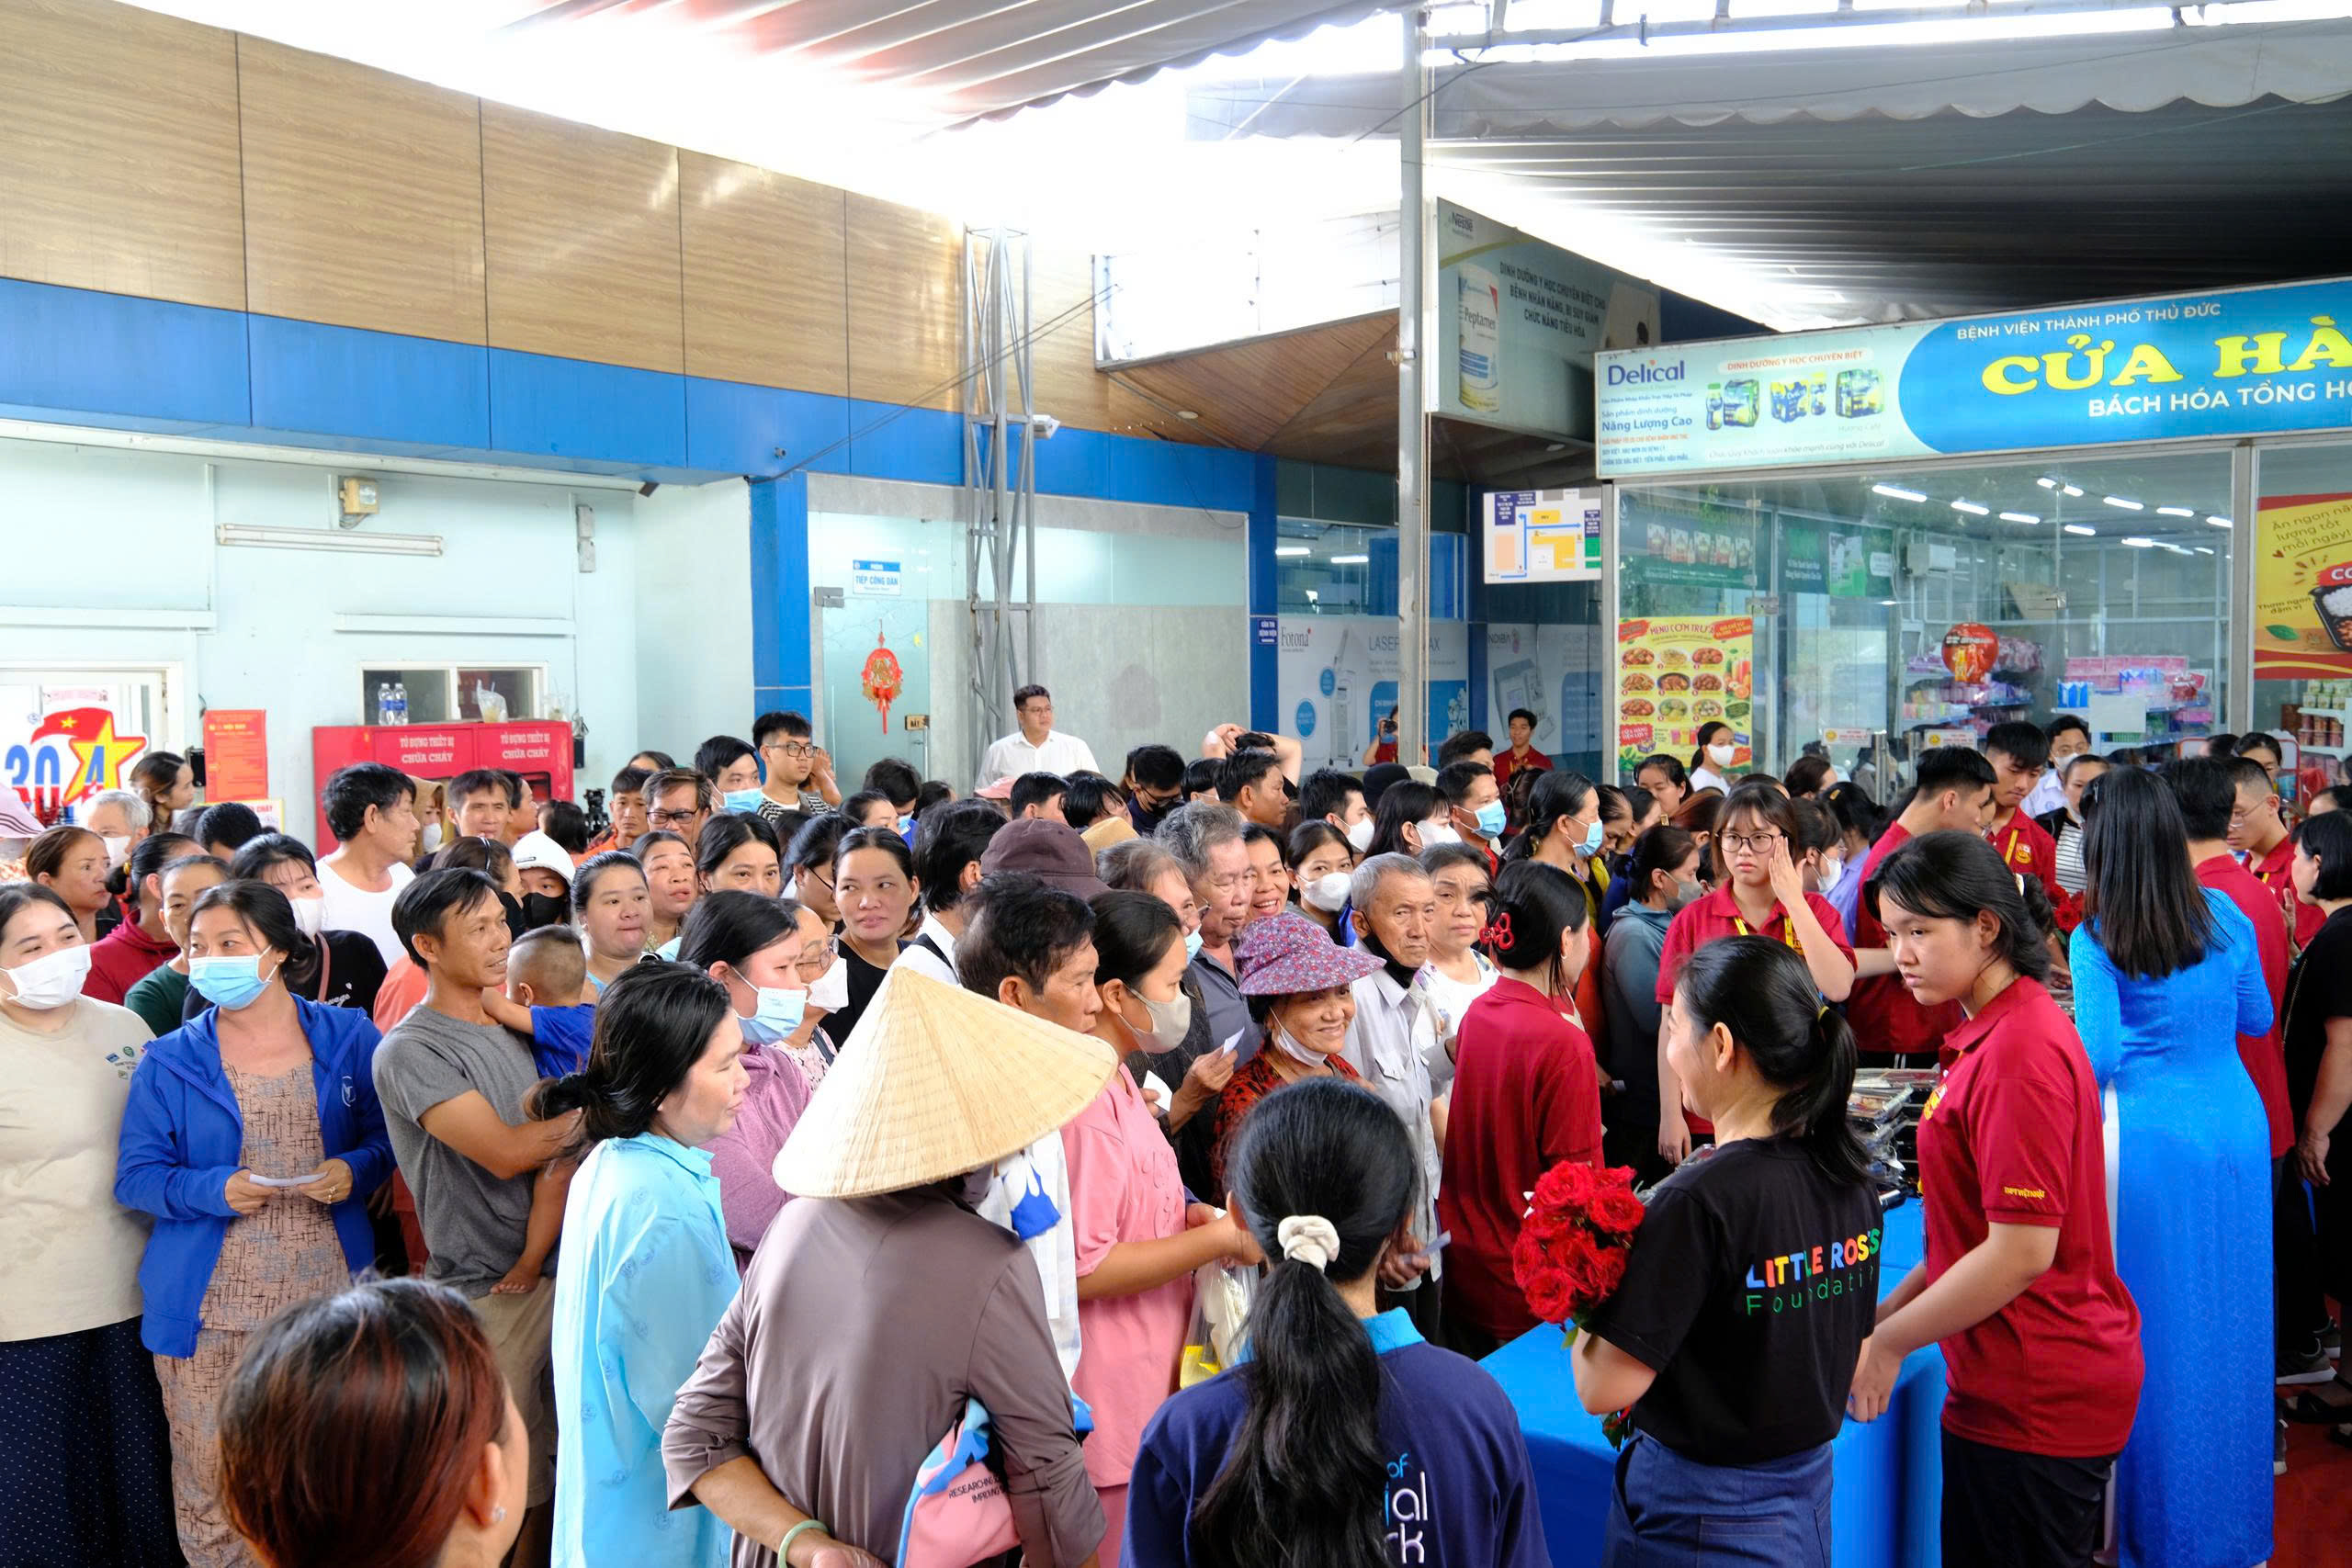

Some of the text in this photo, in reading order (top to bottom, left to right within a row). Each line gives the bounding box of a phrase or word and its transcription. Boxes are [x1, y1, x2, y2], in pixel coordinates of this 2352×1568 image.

[1957, 301, 2222, 341] BỆNH VIỆN THÀNH PHỐ THỦ ĐỨC
[1727, 361, 1748, 371] DINH
[1981, 315, 2352, 396] CỬA HÀ
[1608, 359, 1685, 386] Delical
[2088, 394, 2162, 418] BÁCH
[2170, 386, 2231, 412] HÓA
[2237, 378, 2317, 406] TỔNG
[1601, 415, 1693, 433] Năng Lượng Cao
[2294, 511, 2330, 525] ngon
[2334, 503, 2352, 515] nă
[2277, 519, 2341, 542] lượng tốt
[1281, 626, 1309, 647] Fotona
[1746, 1227, 1882, 1289] LITTLE ROSS
[1386, 1452, 1408, 1478] of
